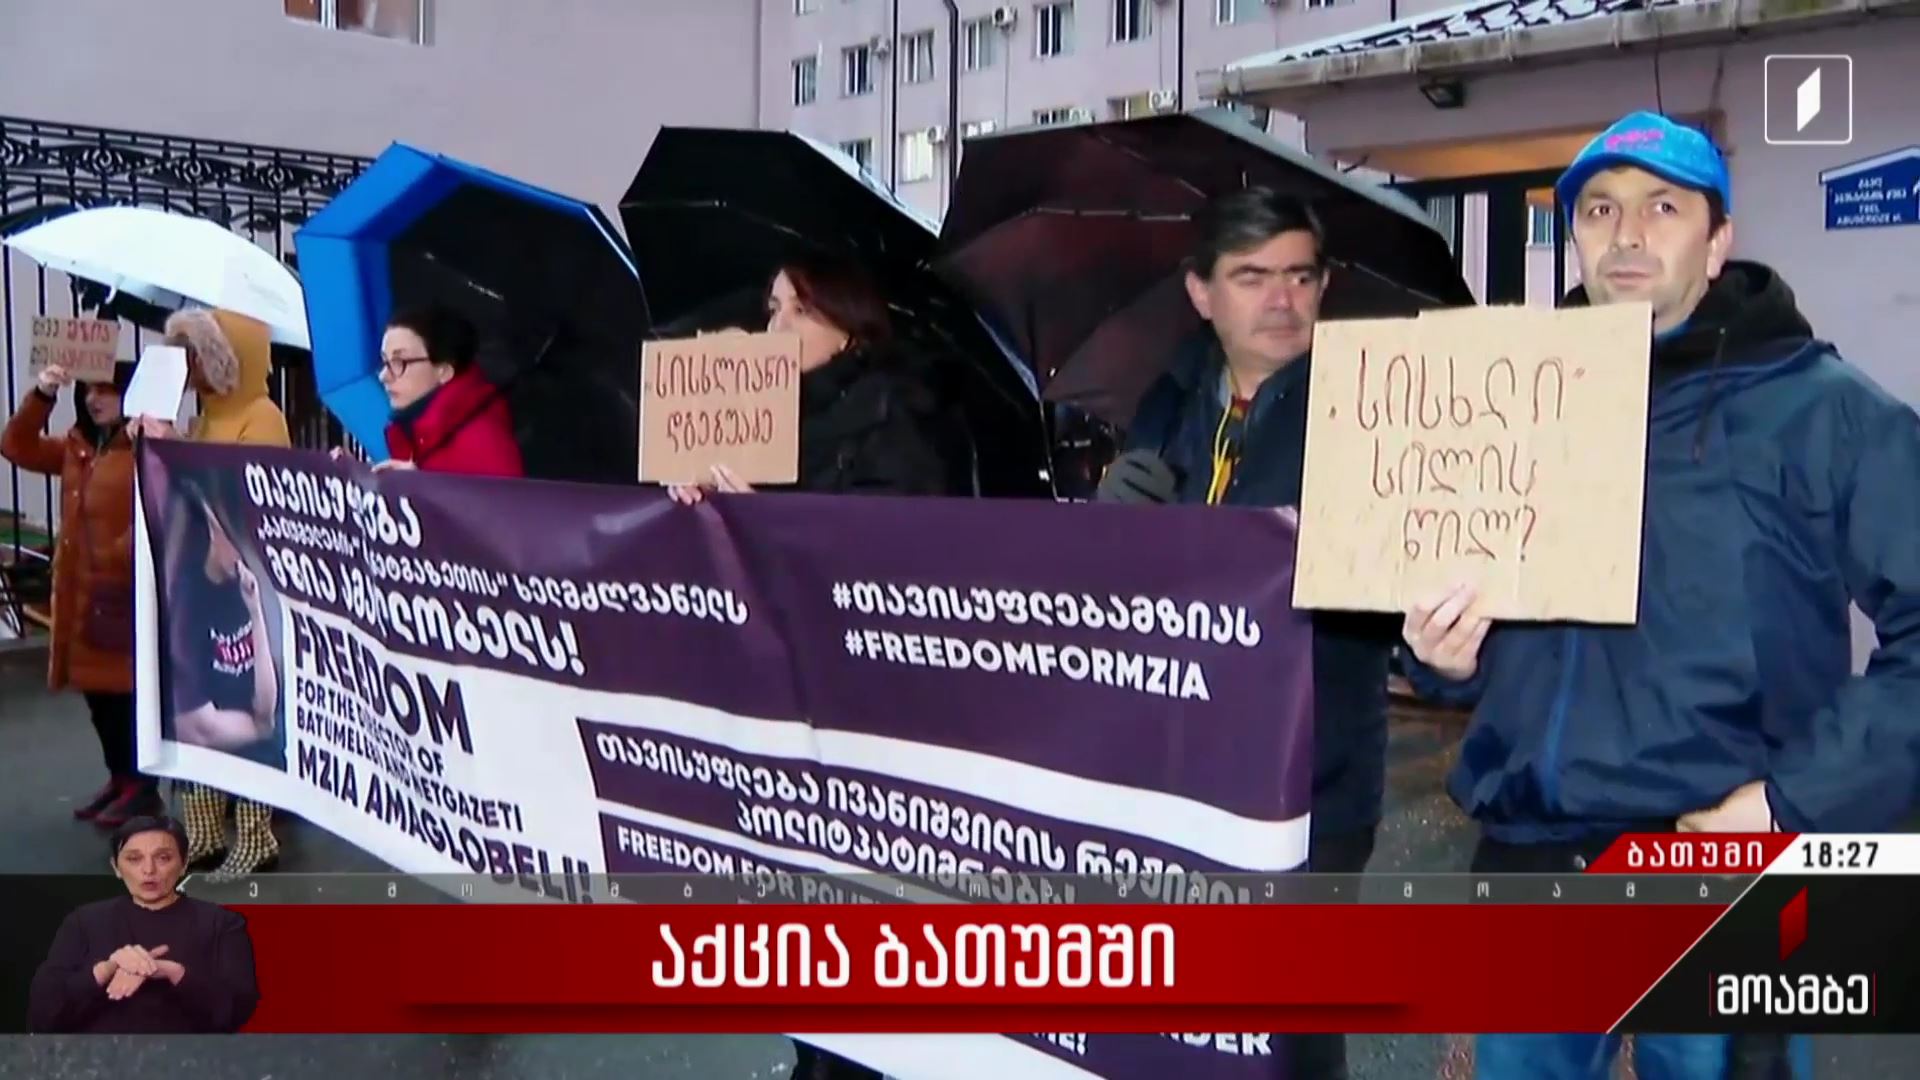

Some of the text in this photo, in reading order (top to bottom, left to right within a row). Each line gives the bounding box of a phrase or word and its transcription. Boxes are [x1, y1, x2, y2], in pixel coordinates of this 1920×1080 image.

[266, 544, 337, 603] მზია
[512, 573, 749, 625] ხელმძღვანელს
[832, 580, 1261, 647] #თავისუფლებამზიას
[290, 607, 474, 755] FREEDOM
[845, 629, 1211, 701] #FREEDOMFORMZIA
[296, 676, 326, 709] FOR
[328, 689, 356, 722] THE
[418, 746, 444, 778] OF
[298, 738, 594, 904] MZIA AMAGLOBELI!
[411, 768, 523, 833] NETGAZETI
[597, 732, 820, 805] თავისუფლება
[826, 777, 1066, 871] ივანიშვილის
[617, 825, 736, 881] FREEDOM
[740, 858, 797, 899] FOR
